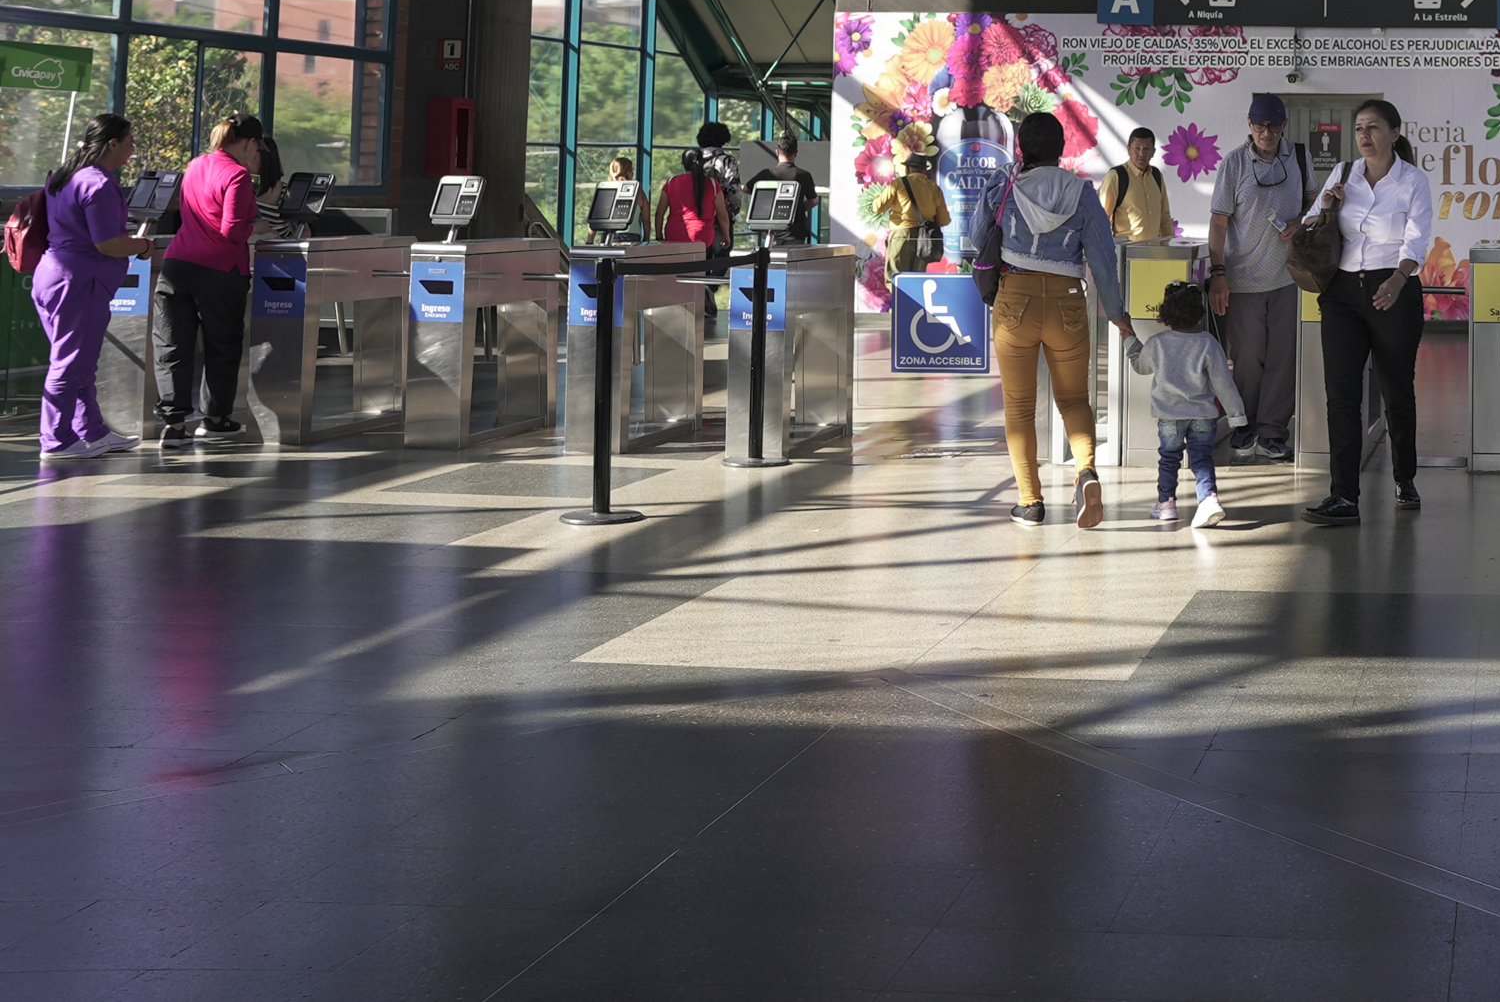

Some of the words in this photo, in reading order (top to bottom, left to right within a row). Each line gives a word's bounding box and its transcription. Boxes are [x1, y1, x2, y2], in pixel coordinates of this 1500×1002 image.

[1188, 10, 1195, 19] A
[1197, 9, 1223, 21] Niquía
[1414, 13, 1420, 21] A
[1423, 13, 1432, 21] La
[1435, 12, 1468, 22] Estrella
[1062, 39, 1088, 49] RON
[1090, 39, 1122, 49] VIEJO
[1126, 39, 1141, 49] DE
[1143, 39, 1191, 51] CALDAS,
[1193, 39, 1218, 49] 35%
[1221, 39, 1247, 50] VOL.
[1250, 40, 1264, 50] EL
[1267, 40, 1311, 50] EXCESO
[1315, 40, 1329, 50] DE
[1333, 40, 1387, 50] ALCOHOL
[1390, 40, 1404, 50] ES
[1408, 40, 1483, 50] PERJUDICIAL
[1103, 52, 1169, 65] PROHÍBASE
[1172, 56, 1186, 65] EL
[1188, 56, 1247, 66] EXPENDIO
[1249, 56, 1265, 66] DE
[1268, 56, 1317, 66] BEBIDAS
[1321, 56, 1410, 67] EMBRIAGANTES
[1413, 56, 1421, 66] A
[1424, 57, 1481, 67] MENORES
[1484, 57, 1499, 67] DE
[1404, 120, 1466, 143] Feria
[956, 153, 996, 168] LICOR
[945, 172, 986, 190] CALD
[110, 298, 136, 306] ngreso
[264, 300, 293, 309] Ingreso
[422, 304, 450, 313] Ingreso
[581, 308, 597, 317] Ingr
[900, 357, 926, 365] ZONA
[928, 357, 982, 365] ACCESIBLE
